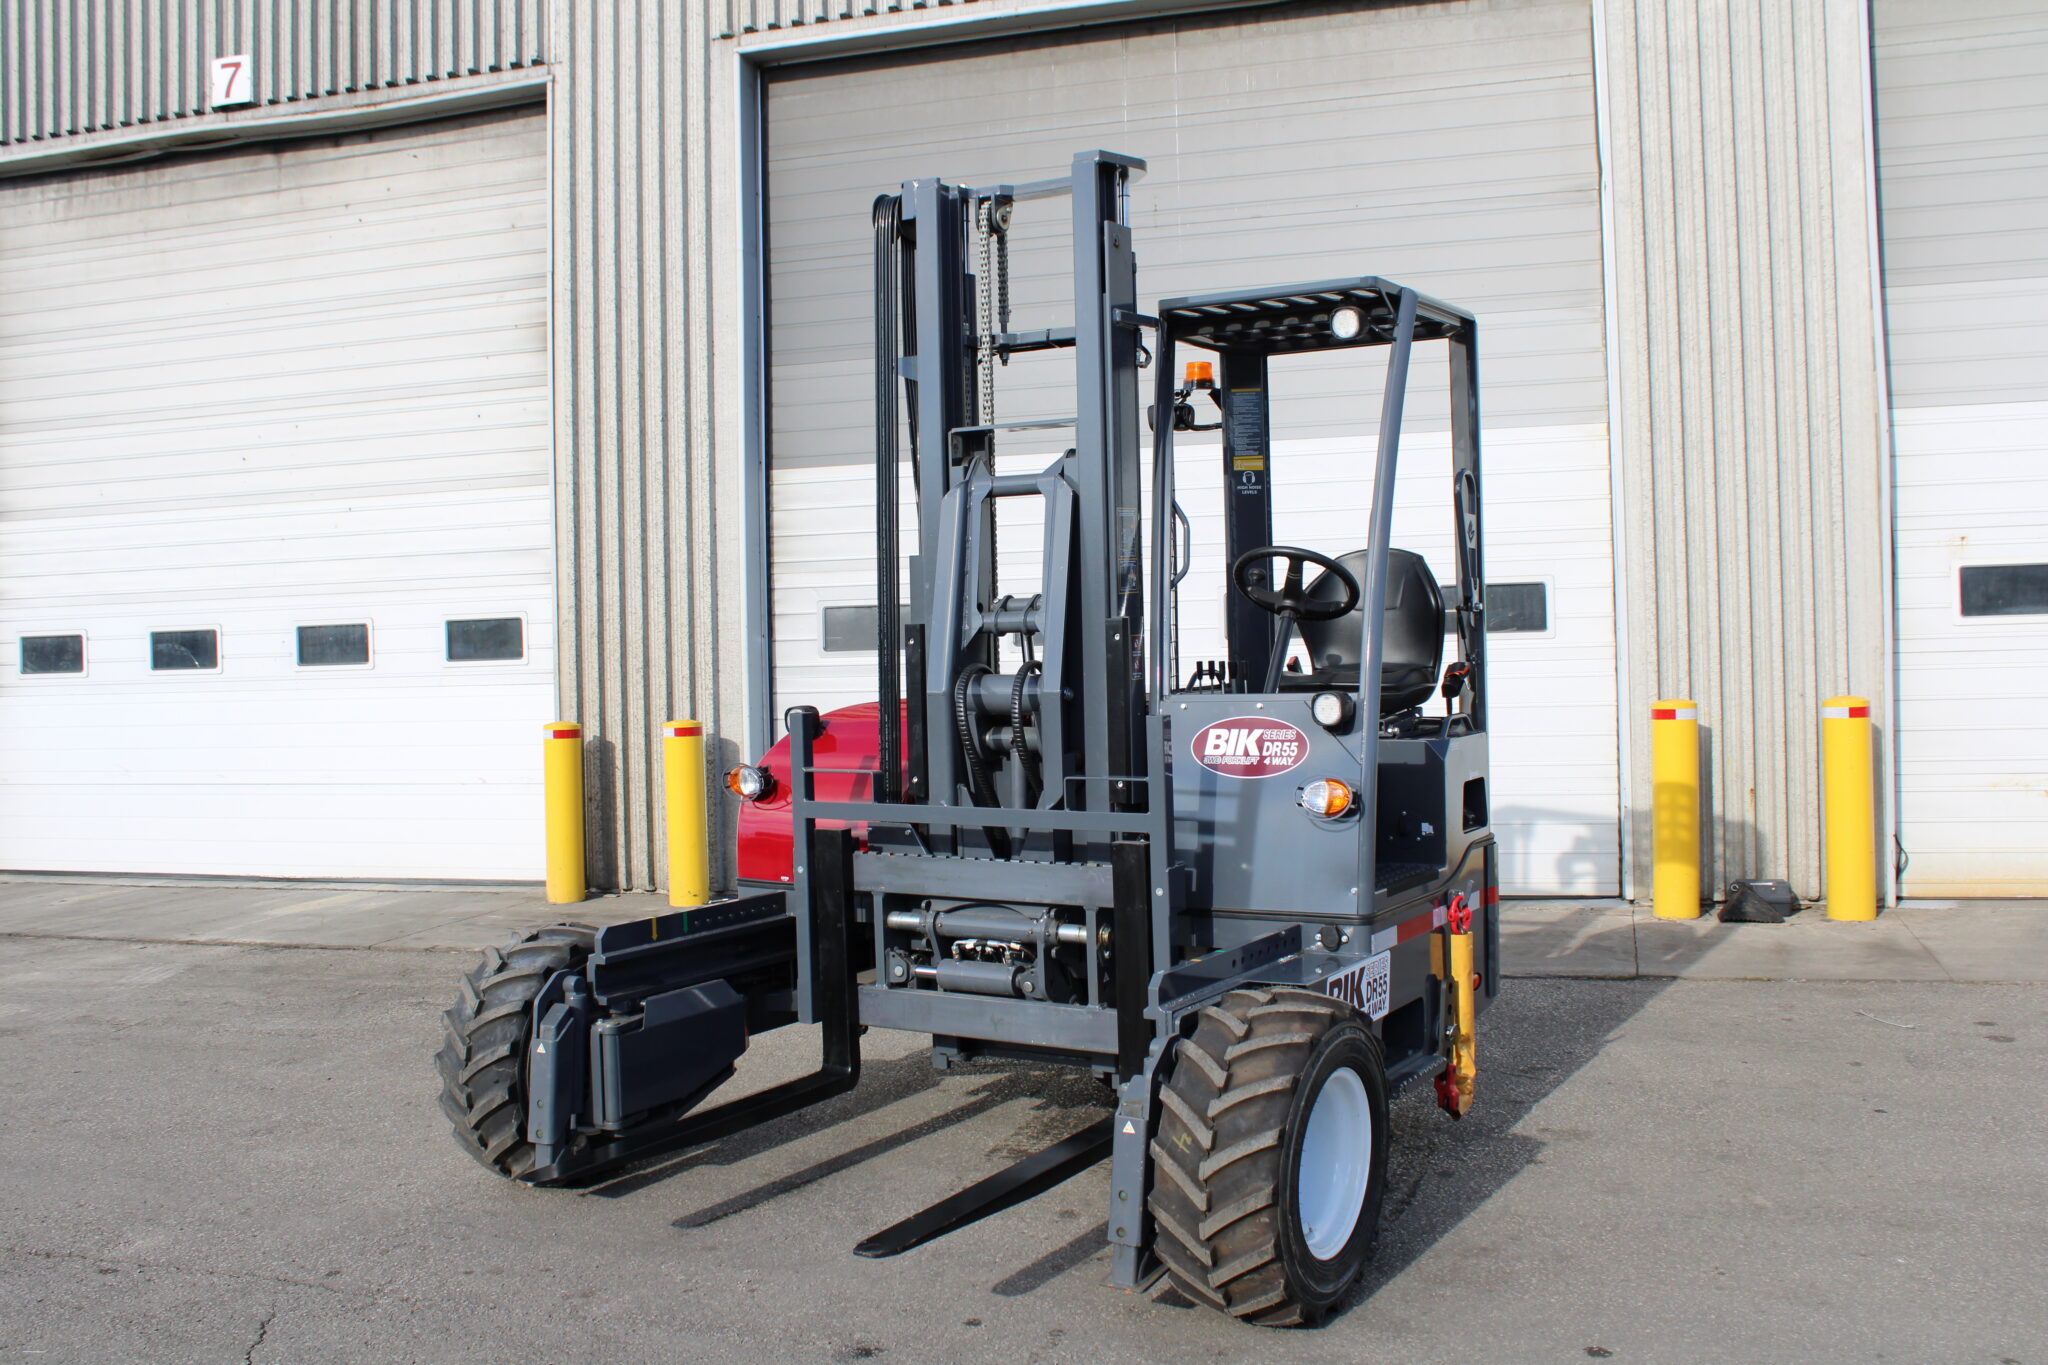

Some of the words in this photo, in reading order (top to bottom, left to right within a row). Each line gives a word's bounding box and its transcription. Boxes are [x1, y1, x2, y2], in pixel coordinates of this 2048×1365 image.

[221, 62, 241, 98] 7
[1204, 728, 1264, 756] BIK
[1263, 729, 1297, 740] SERIES
[1262, 741, 1298, 756] DR55
[1263, 757, 1271, 765] 4
[1365, 955, 1388, 980] SERIES
[1366, 973, 1388, 1004] DR55
